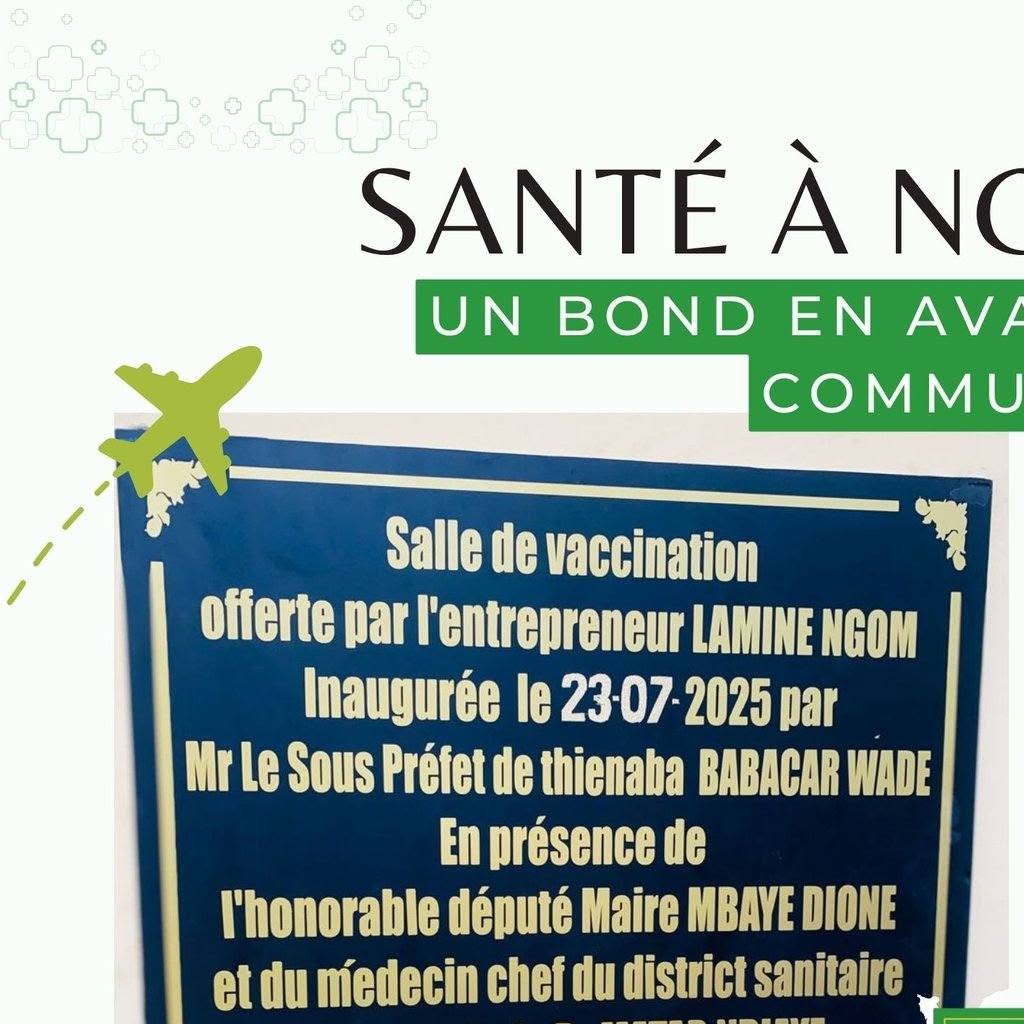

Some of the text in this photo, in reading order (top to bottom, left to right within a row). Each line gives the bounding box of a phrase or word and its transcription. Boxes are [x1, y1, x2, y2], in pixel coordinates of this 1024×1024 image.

[386, 516, 757, 582] Salle de vaccination
[201, 588, 917, 658] offerte par l'entrepreneur LAMINE NGOM
[305, 667, 500, 726] Inaugurée
[518, 673, 551, 723] le
[780, 687, 838, 731] par
[186, 741, 931, 796] Mr Le Sous Préfet de thienaba BABACAR WADE
[440, 816, 705, 870] En présence de
[221, 885, 896, 939] l'honorable député Maire MBAYE DIONE
[214, 965, 252, 1011] et
[261, 961, 307, 1009] du
[488, 956, 565, 1003] chef
[573, 956, 615, 1001] du
[624, 954, 746, 1000] district
[755, 952, 903, 997] sanitaire
